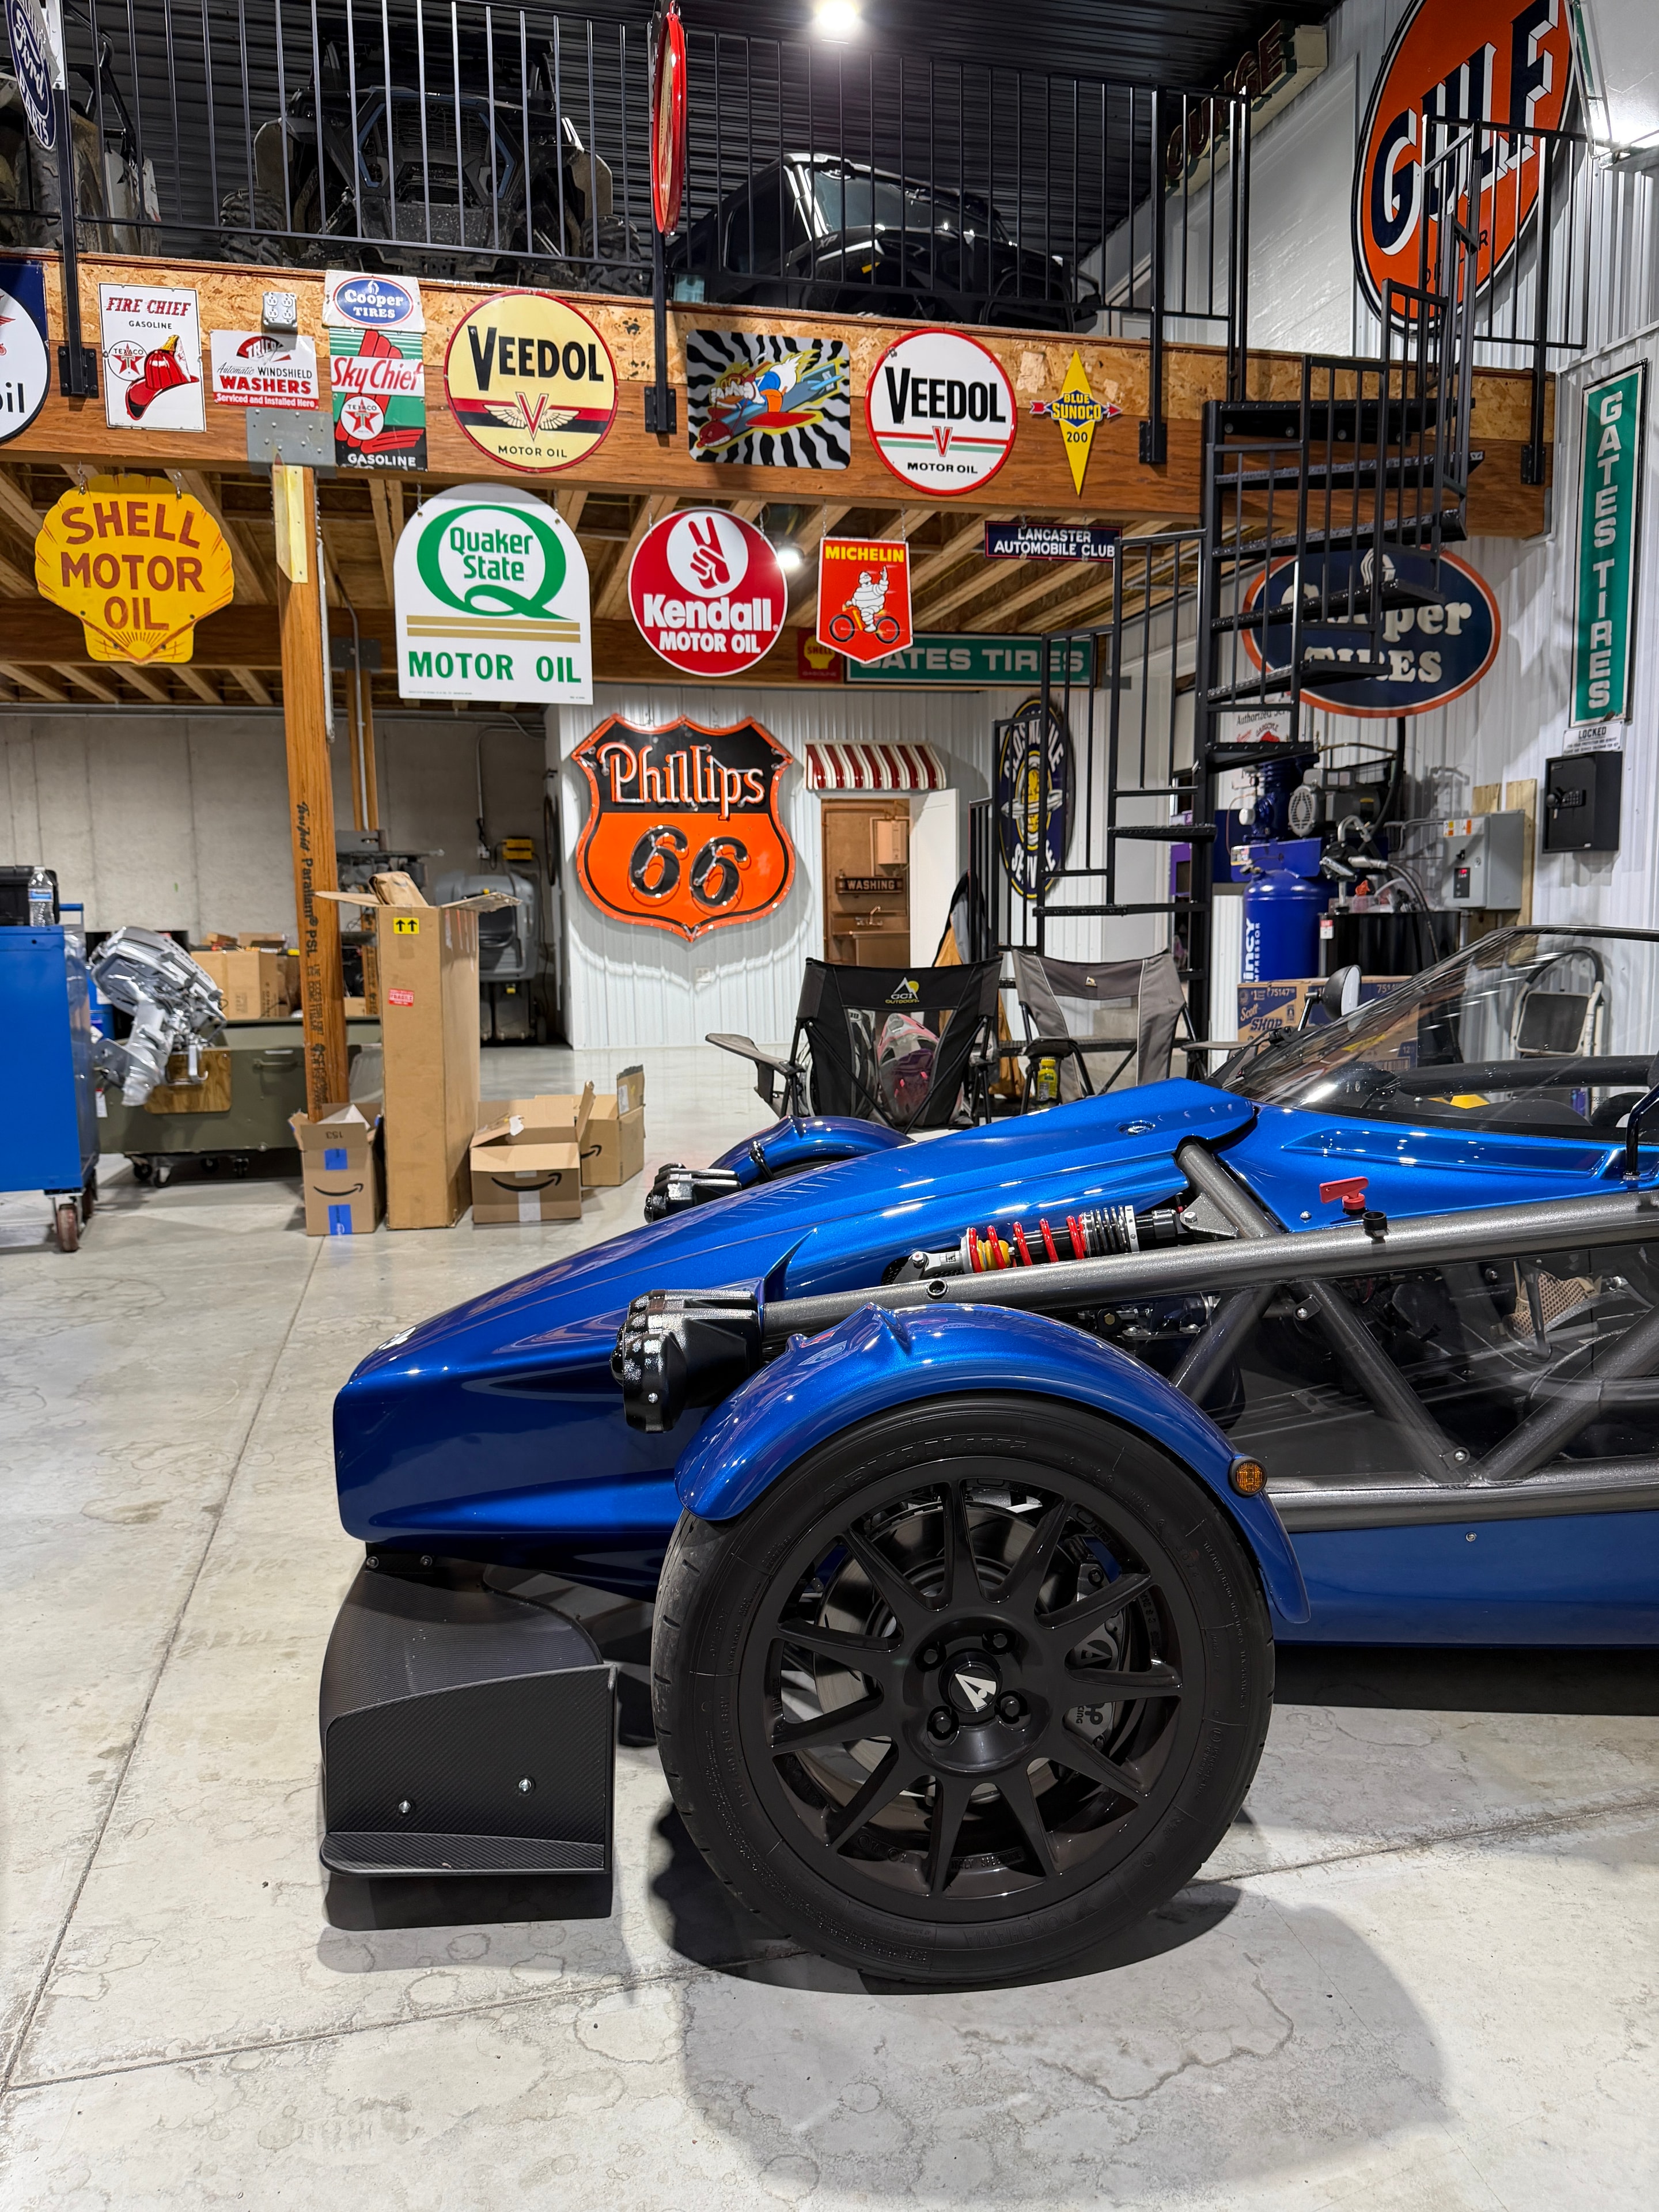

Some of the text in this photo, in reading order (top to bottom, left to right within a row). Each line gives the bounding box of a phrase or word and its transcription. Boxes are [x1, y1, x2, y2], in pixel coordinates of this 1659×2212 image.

[20, 67, 49, 145] PARTS
[816, 234, 838, 251] XP
[106, 297, 191, 316] FIRE CHIEF
[344, 289, 404, 308] Cooper
[353, 306, 395, 319] TIRES
[128, 320, 172, 329] GASOLINE
[467, 325, 604, 392] VEEDOL
[217, 362, 312, 378] Automatic WINDSHIELD
[331, 357, 424, 393] Sky Chief
[219, 375, 312, 395] WASHERS
[216, 393, 315, 407] Serviced and Installed Here
[884, 366, 1006, 425] VEEDOL
[1063, 393, 1090, 404] BLUE
[1052, 403, 1103, 421] SUNOCO
[1066, 431, 1088, 443] 200
[347, 453, 416, 467] GASOLINE
[498, 444, 567, 459] MOTOR OIL
[907, 462, 978, 474] MOTOR OIL
[1594, 391, 1623, 549] GATES
[61, 501, 200, 550] SHELL
[450, 527, 533, 556] Quaker
[1017, 528, 1092, 543] LANCASTER
[825, 546, 904, 562] MICHELIN
[994, 540, 1115, 557] AUTOMOBILE CLUB
[60, 551, 206, 593] MOTOR
[463, 555, 525, 582] State
[104, 596, 170, 631] OIL
[642, 593, 774, 632] Kendall
[659, 632, 761, 654] MOTOR OIL
[1588, 559, 1616, 710] TIRES
[807, 645, 834, 656] SHELL
[860, 647, 972, 671] ATES
[408, 651, 582, 683] MOTOR OIL
[1578, 726, 1607, 740] LOCKED
[599, 741, 766, 820] Phillips
[629, 824, 749, 908] 66
[847, 879, 895, 891] WASHING
[305, 929, 317, 958] PSL
[1240, 1003, 1259, 1022] Scott
